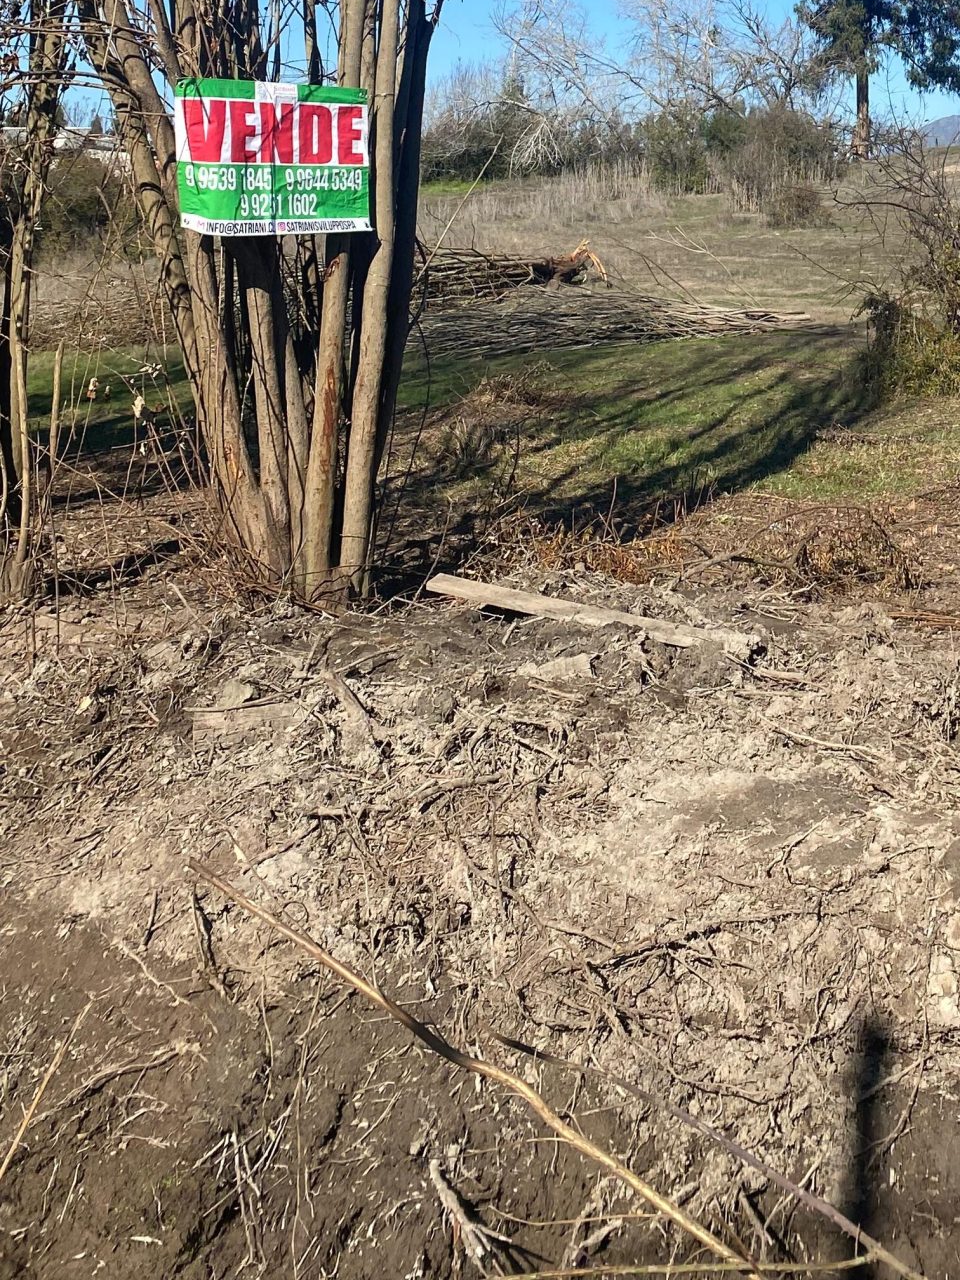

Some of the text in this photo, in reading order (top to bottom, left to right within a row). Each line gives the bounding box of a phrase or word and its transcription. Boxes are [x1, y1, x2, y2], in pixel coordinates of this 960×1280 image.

[181, 99, 364, 164] VENDE
[185, 165, 272, 190] 9 9539 1845
[285, 169, 362, 191] 9 9644 5349
[241, 193, 249, 216] 9
[288, 193, 317, 216] 1602
